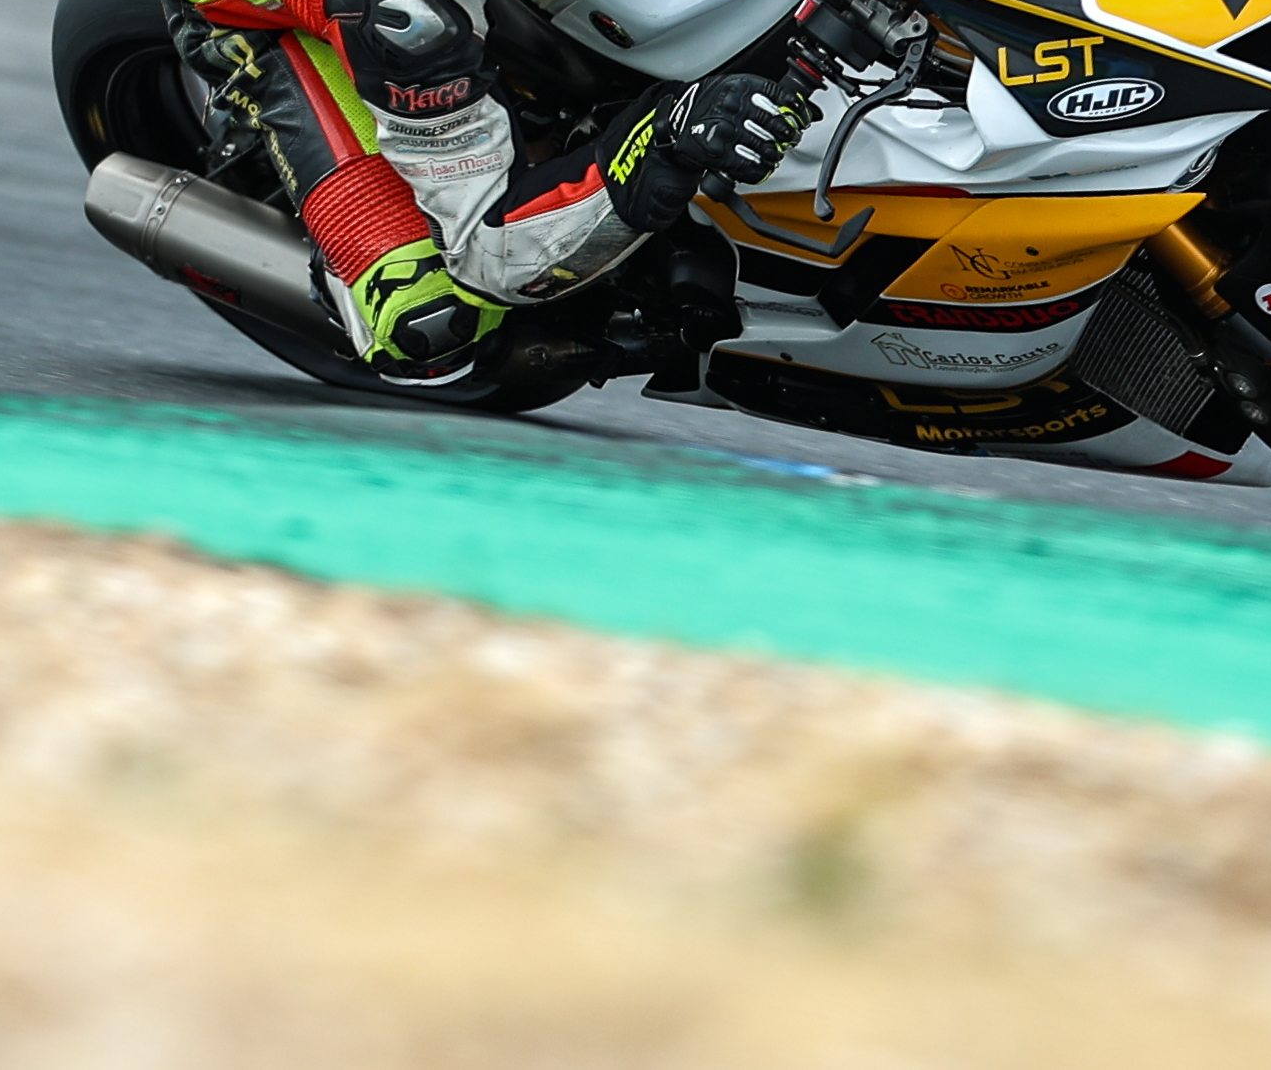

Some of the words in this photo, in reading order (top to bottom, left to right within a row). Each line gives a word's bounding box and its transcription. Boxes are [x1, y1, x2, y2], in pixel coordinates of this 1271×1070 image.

[998, 36, 1104, 86] LST
[1064, 84, 1152, 116] HJC
[924, 349, 992, 366] Carlos
[993, 341, 1061, 366] Couto
[916, 403, 1108, 443] Motorsports
